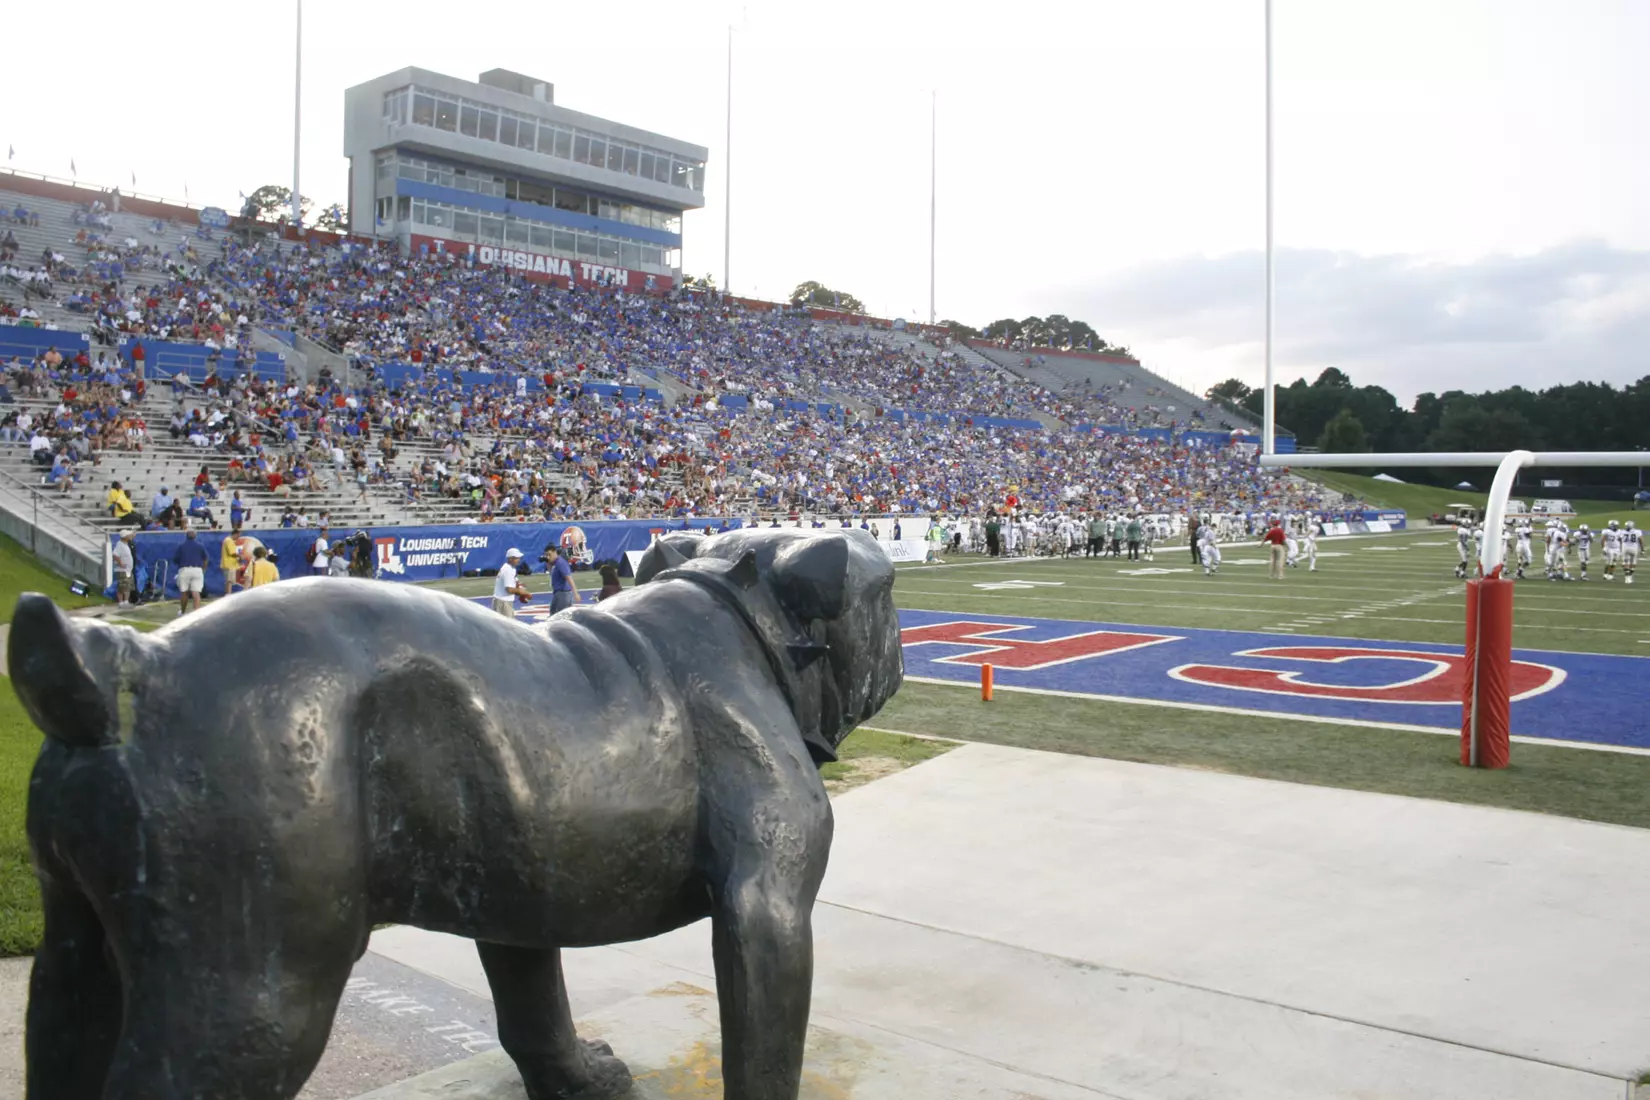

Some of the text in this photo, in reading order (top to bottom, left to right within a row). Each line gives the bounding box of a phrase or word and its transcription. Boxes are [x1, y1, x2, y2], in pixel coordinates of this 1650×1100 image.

[581, 262, 629, 286] TECH
[399, 535, 489, 552] LOUISIANA TECH
[1623, 533, 1637, 543] 78
[406, 551, 470, 567] UNIVERSITY
